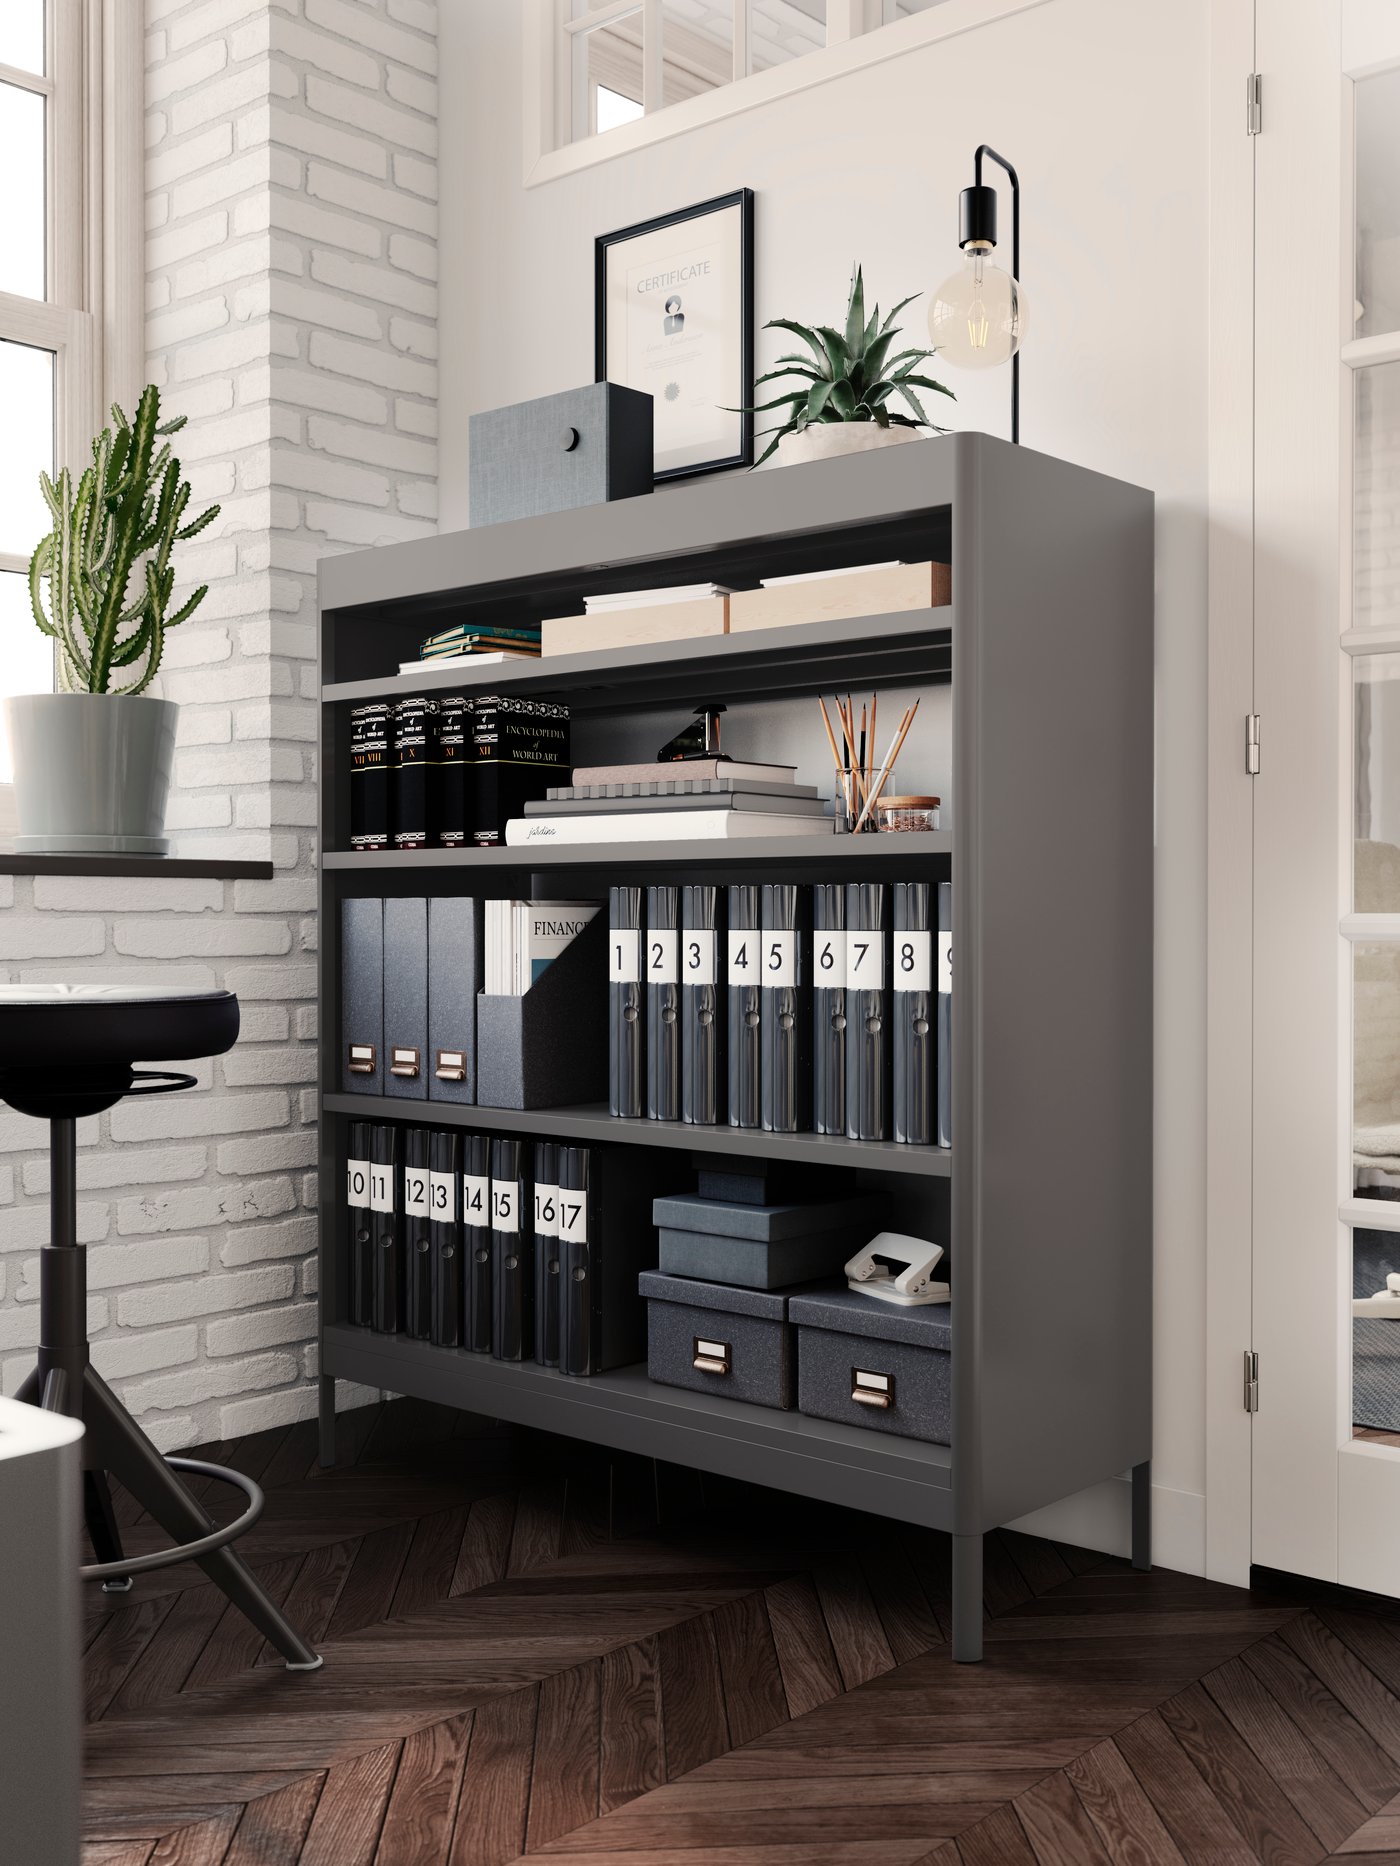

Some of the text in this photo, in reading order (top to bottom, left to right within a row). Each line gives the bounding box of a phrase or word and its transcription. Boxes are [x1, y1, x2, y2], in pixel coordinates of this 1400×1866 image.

[636, 260, 711, 293] CERTIFICATE
[506, 725, 565, 739] ENCYCLOPEDIA
[367, 752, 381, 762] VIII
[409, 748, 415, 758] X
[446, 747, 454, 757] XI
[479, 745, 491, 755] XII
[512, 749, 559, 762] WORLD ART
[532, 740, 541, 751] of
[615, 945, 622, 971] 1
[651, 942, 664, 969] 2
[688, 942, 701, 969] 3
[733, 941, 749, 969] 4
[768, 943, 783, 971] 5
[820, 942, 834, 970] 6
[853, 943, 870, 972] 7
[900, 943, 915, 972] 8
[347, 1170, 365, 1195] 10
[372, 1175, 385, 1200] 11
[406, 1178, 425, 1204] 12
[430, 1183, 448, 1209] 13
[465, 1186, 483, 1212] 14
[493, 1191, 511, 1218] 15
[535, 1195, 556, 1222] 16
[560, 1203, 582, 1230] 17
